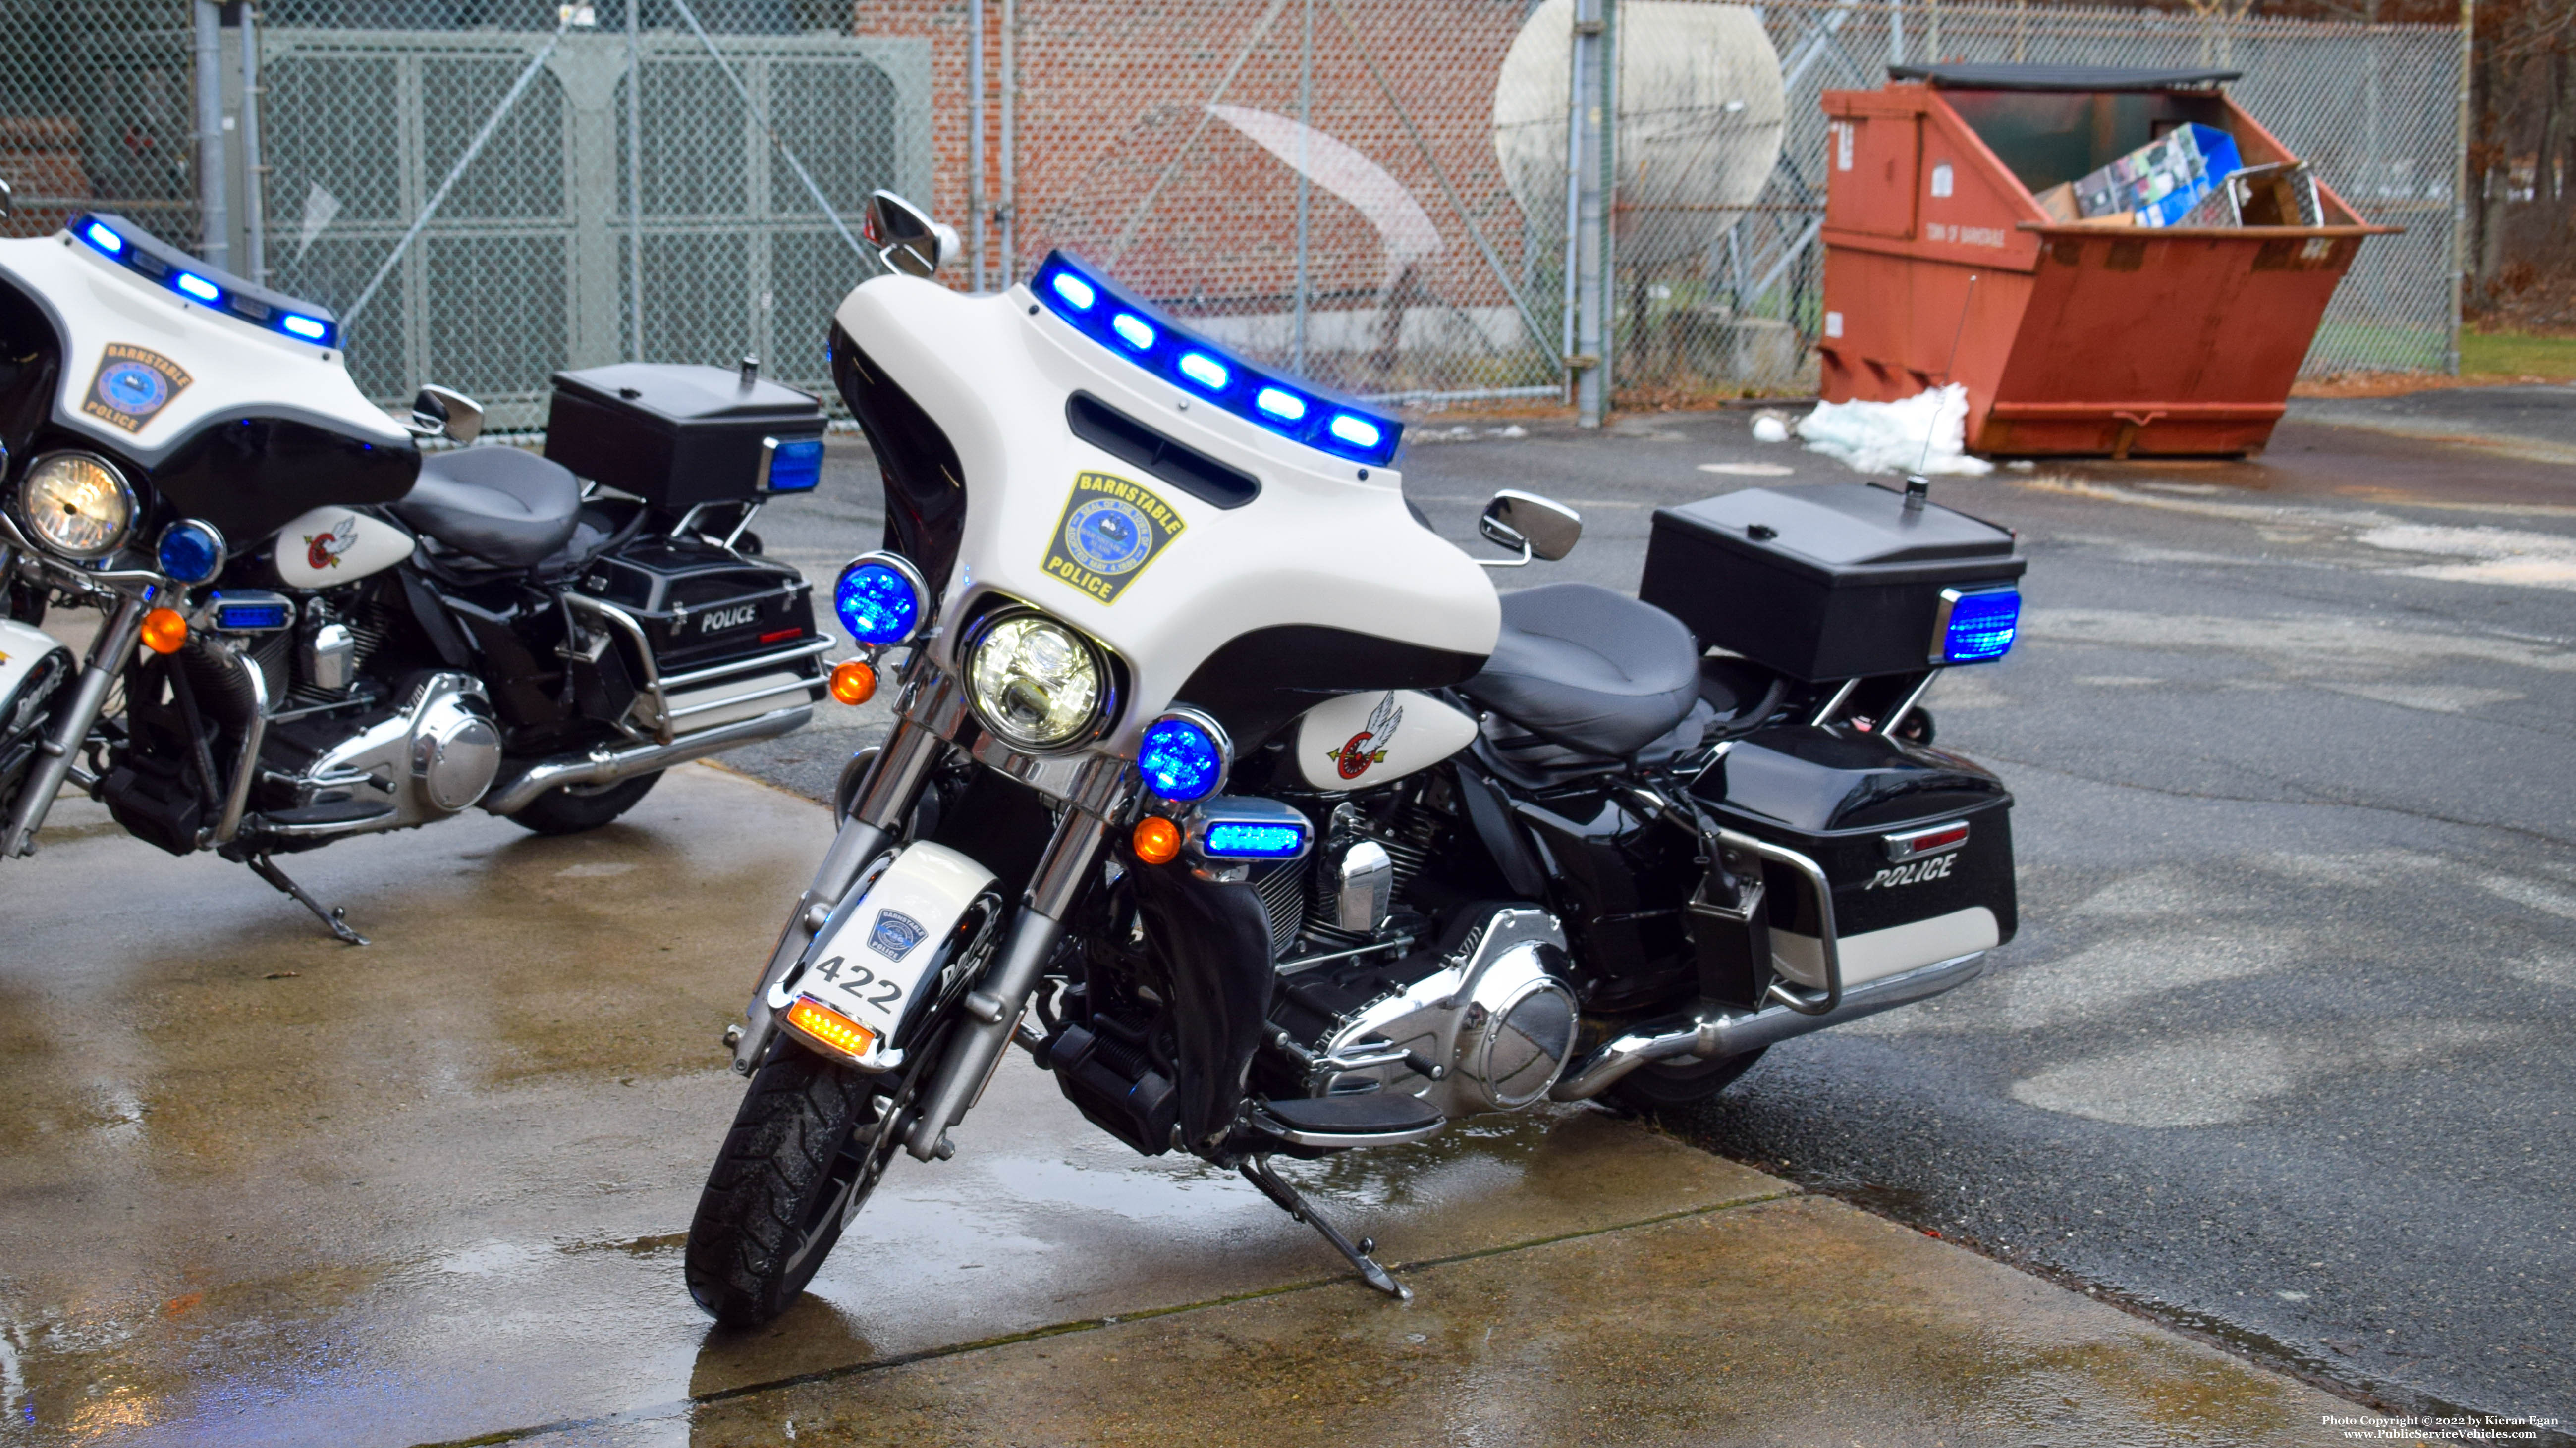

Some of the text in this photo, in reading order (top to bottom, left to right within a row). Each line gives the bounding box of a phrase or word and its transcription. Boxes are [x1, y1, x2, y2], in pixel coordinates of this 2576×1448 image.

[108, 345, 190, 388] BARNSTABLE
[86, 401, 138, 430] POLICE
[1080, 475, 1182, 536] BARNSTABLE
[1048, 555, 1113, 599] POLICE
[700, 604, 756, 633] POLICE
[1864, 853, 1958, 890] POLICE
[883, 911, 925, 936] BARNSTABLE
[872, 941, 899, 959] POLICE
[816, 956, 902, 1015] 422
